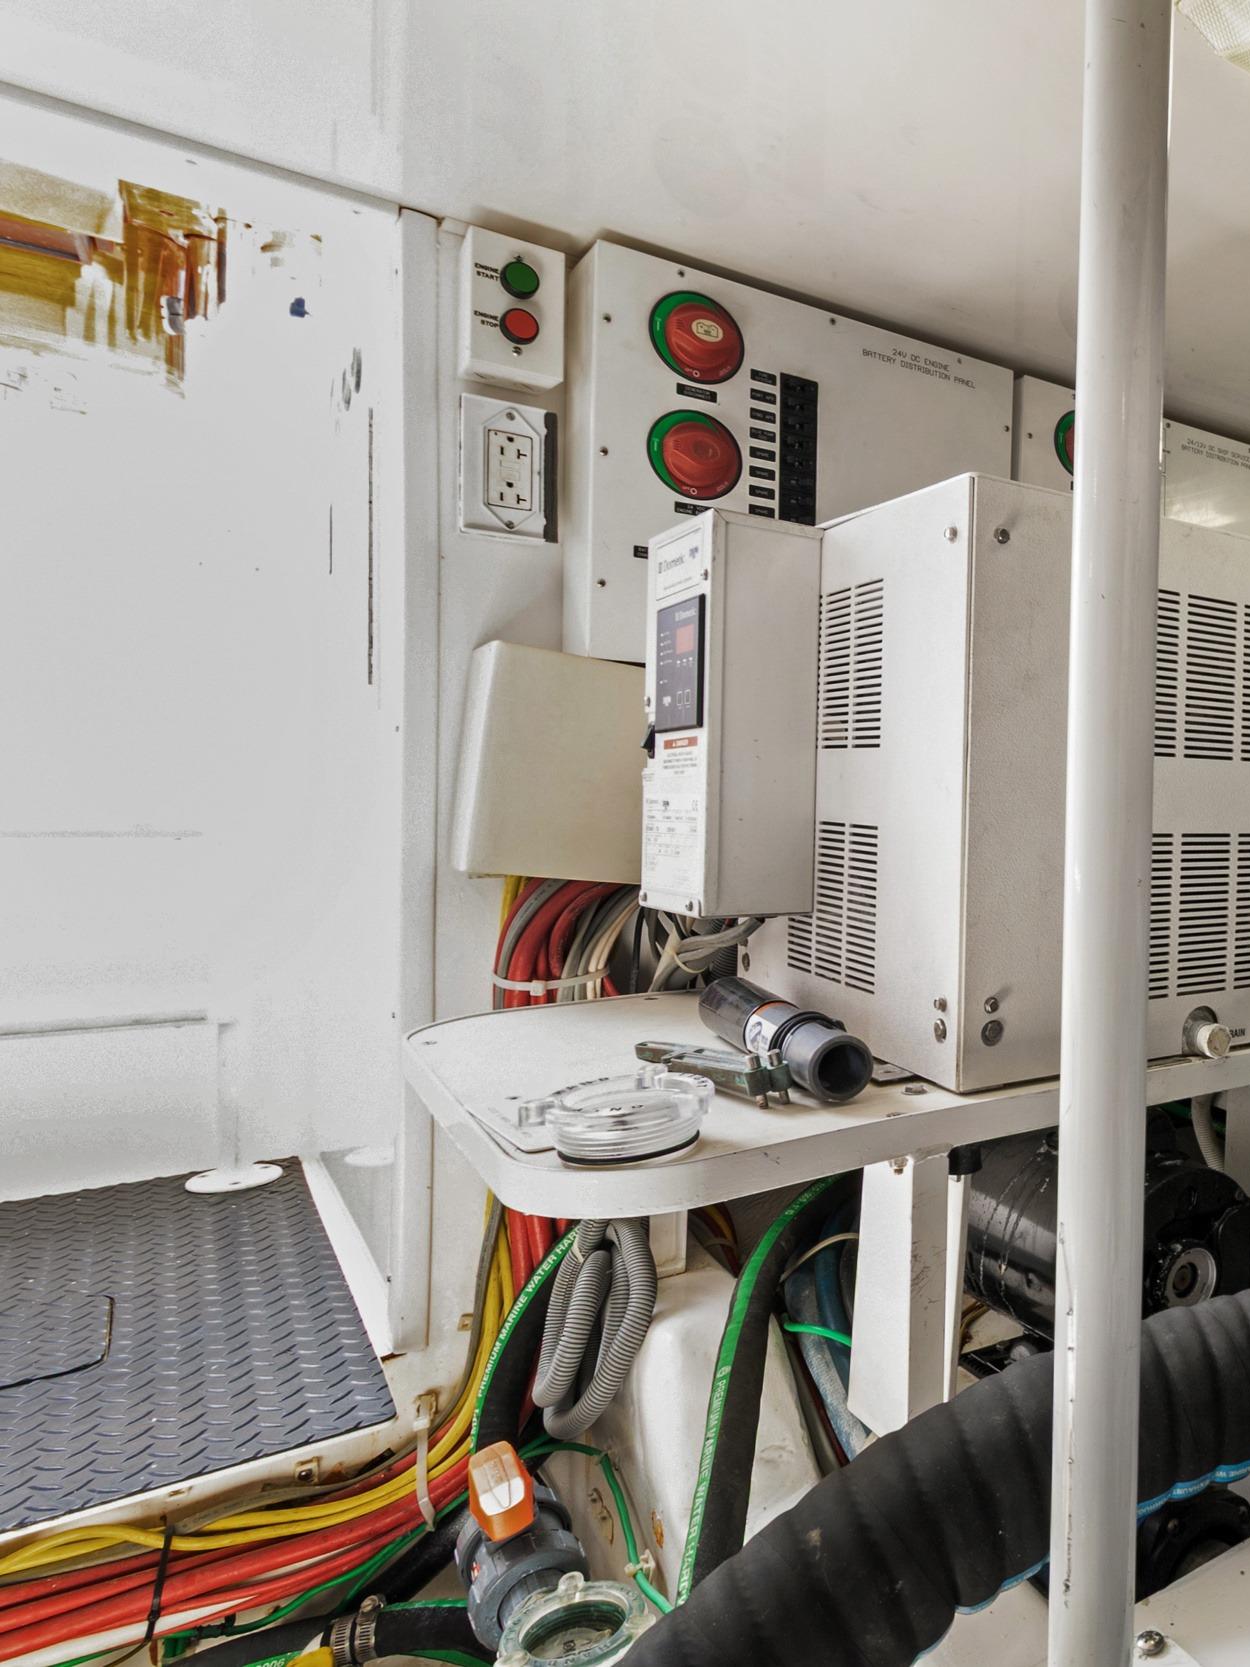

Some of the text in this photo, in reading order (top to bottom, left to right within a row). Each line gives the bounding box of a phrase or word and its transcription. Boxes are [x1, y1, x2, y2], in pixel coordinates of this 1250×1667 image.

[474, 262, 499, 273] ENGINE
[476, 270, 500, 281] START
[473, 310, 499, 321] ENGINE
[480, 319, 500, 328] STOP
[862, 348, 976, 389] BATTERY DISTRIBUTION PANEL
[892, 348, 950, 372] 24V DC ENGINE
[1181, 443, 1204, 456] BATTERY
[1205, 450, 1240, 467] DISTRIBUTION
[477, 1341, 502, 1397] PREMIUM
[500, 1295, 527, 1340] MARINE
[525, 1253, 557, 1293] WATER
[708, 1379, 727, 1430] PREMIUM
[699, 1429, 718, 1480] MARINE
[689, 1480, 711, 1539] WATER
